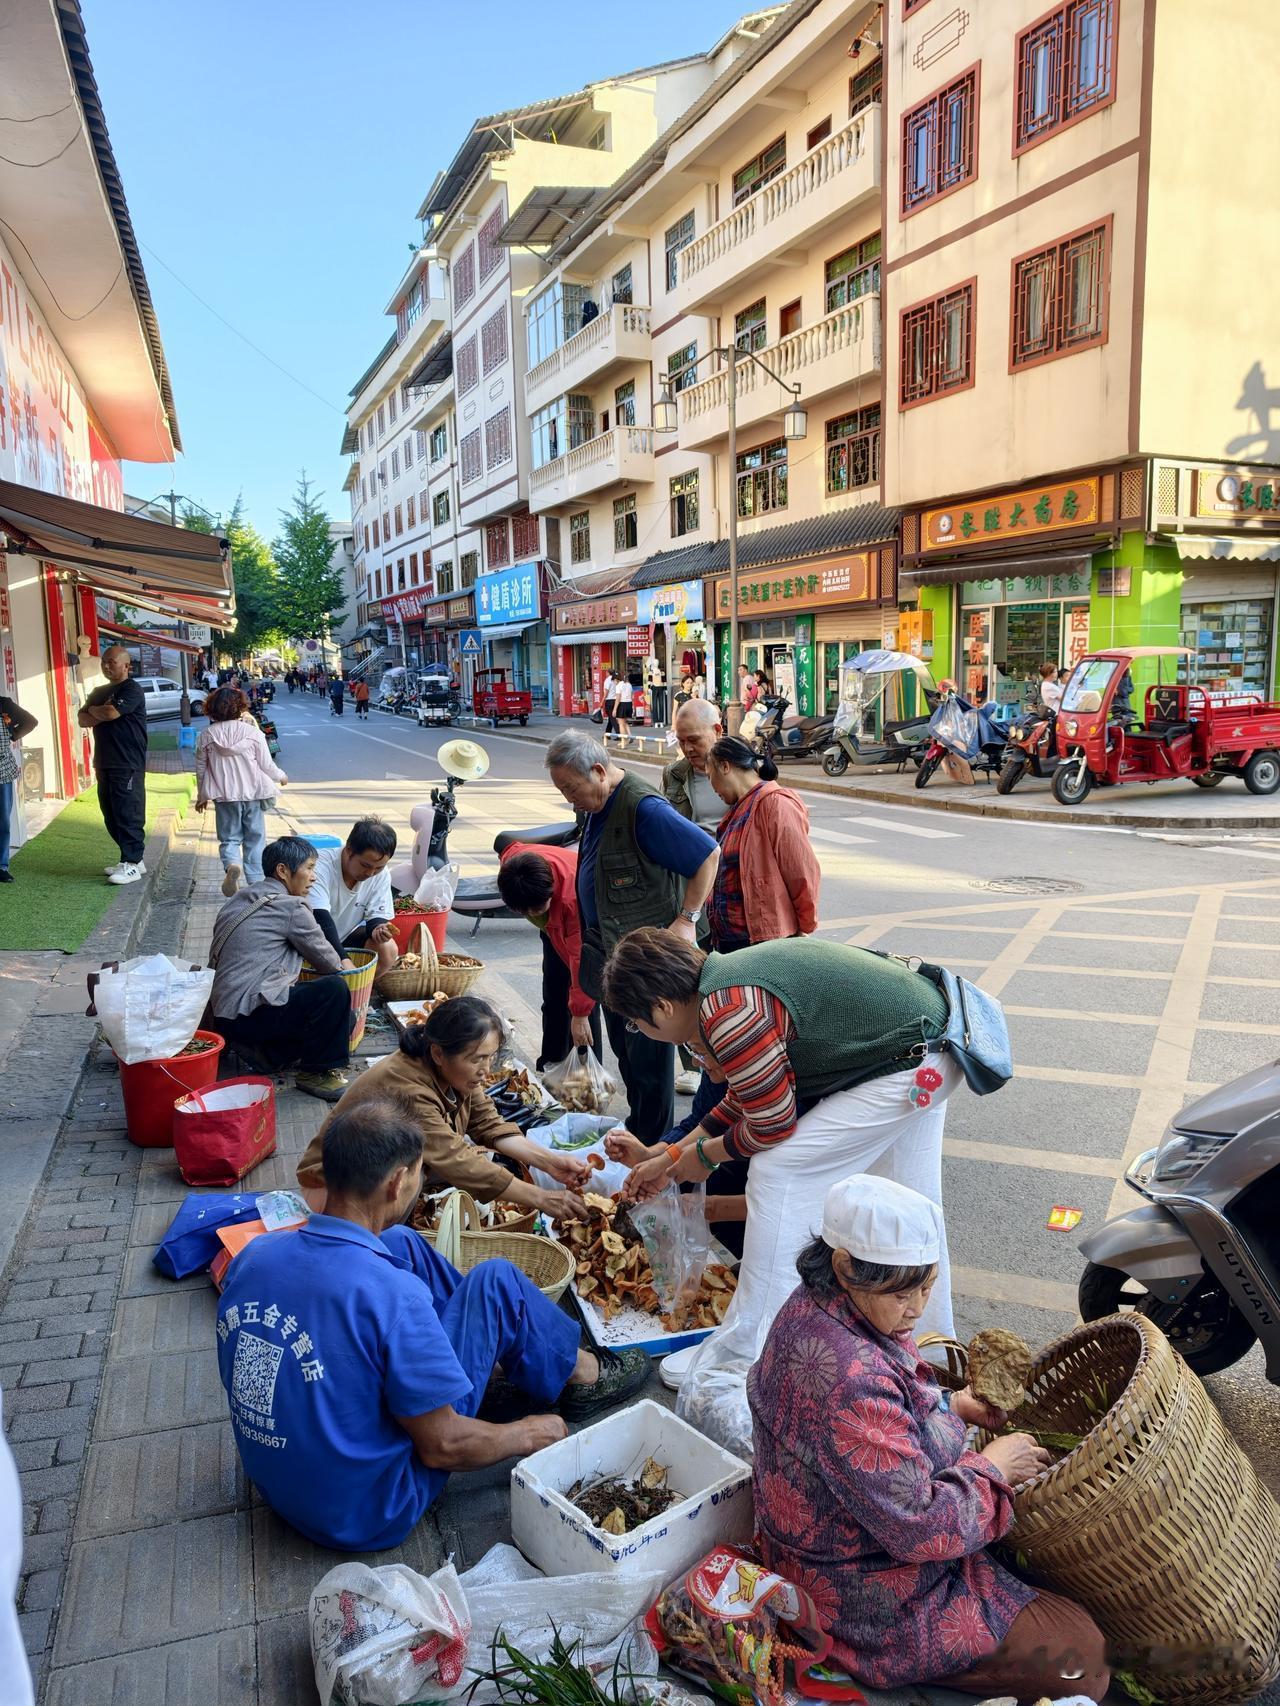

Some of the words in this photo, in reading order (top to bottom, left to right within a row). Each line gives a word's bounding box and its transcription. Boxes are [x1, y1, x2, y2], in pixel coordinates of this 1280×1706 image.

[960, 489, 1080, 538] 长胜大药房
[1241, 481, 1280, 511] 长胜
[491, 575, 532, 612] 健盾诊所
[1218, 1241, 1273, 1325] LUYUAN
